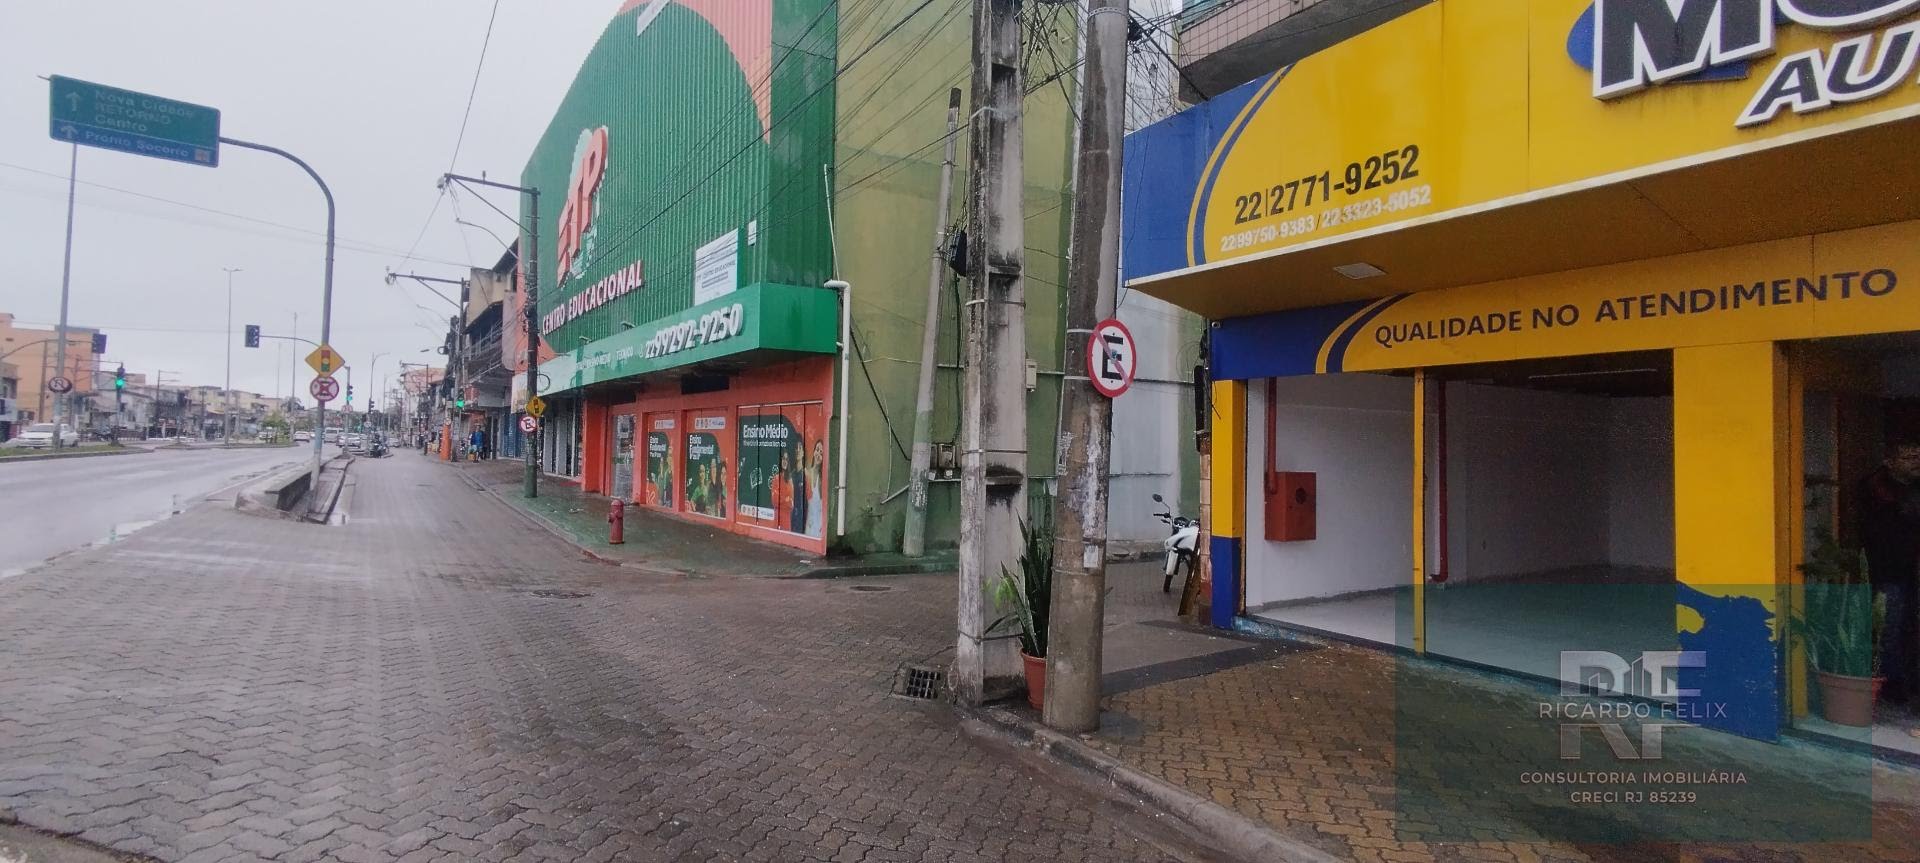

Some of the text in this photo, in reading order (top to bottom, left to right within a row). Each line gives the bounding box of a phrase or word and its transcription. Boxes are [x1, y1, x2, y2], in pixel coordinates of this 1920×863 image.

[1735, 22, 1920, 129] AU
[95, 89, 135, 107] Nova
[95, 103, 172, 126] RETORNO
[95, 114, 148, 133] Centro
[85, 131, 190, 158] Pronto Socorro
[542, 259, 644, 336] CENTRO EDUCACIONAL
[1374, 267, 1898, 348] QUALIDADE NO ATENDIMENTO
[1101, 334, 1124, 381] E
[743, 423, 789, 439] Ensino Médio
